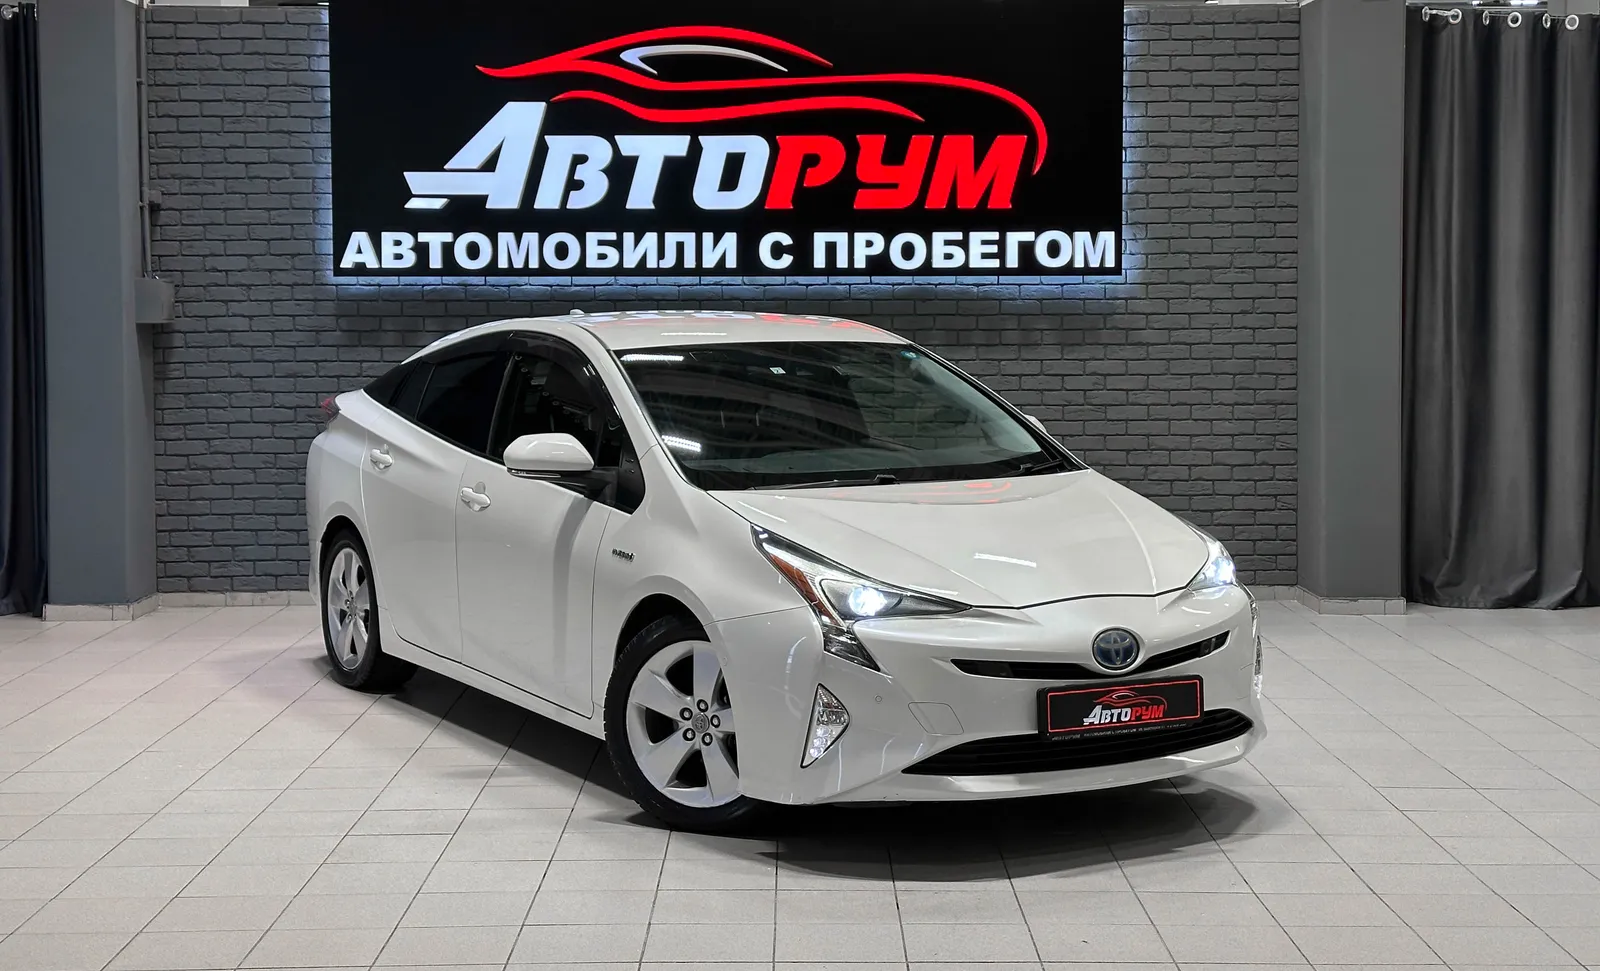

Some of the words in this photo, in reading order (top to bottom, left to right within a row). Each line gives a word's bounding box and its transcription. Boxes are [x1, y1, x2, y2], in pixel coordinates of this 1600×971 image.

[340, 231, 737, 270] АВТОМОБИЛИ
[758, 231, 794, 270] С
[813, 230, 1116, 270] ПРОБЕГОМ
